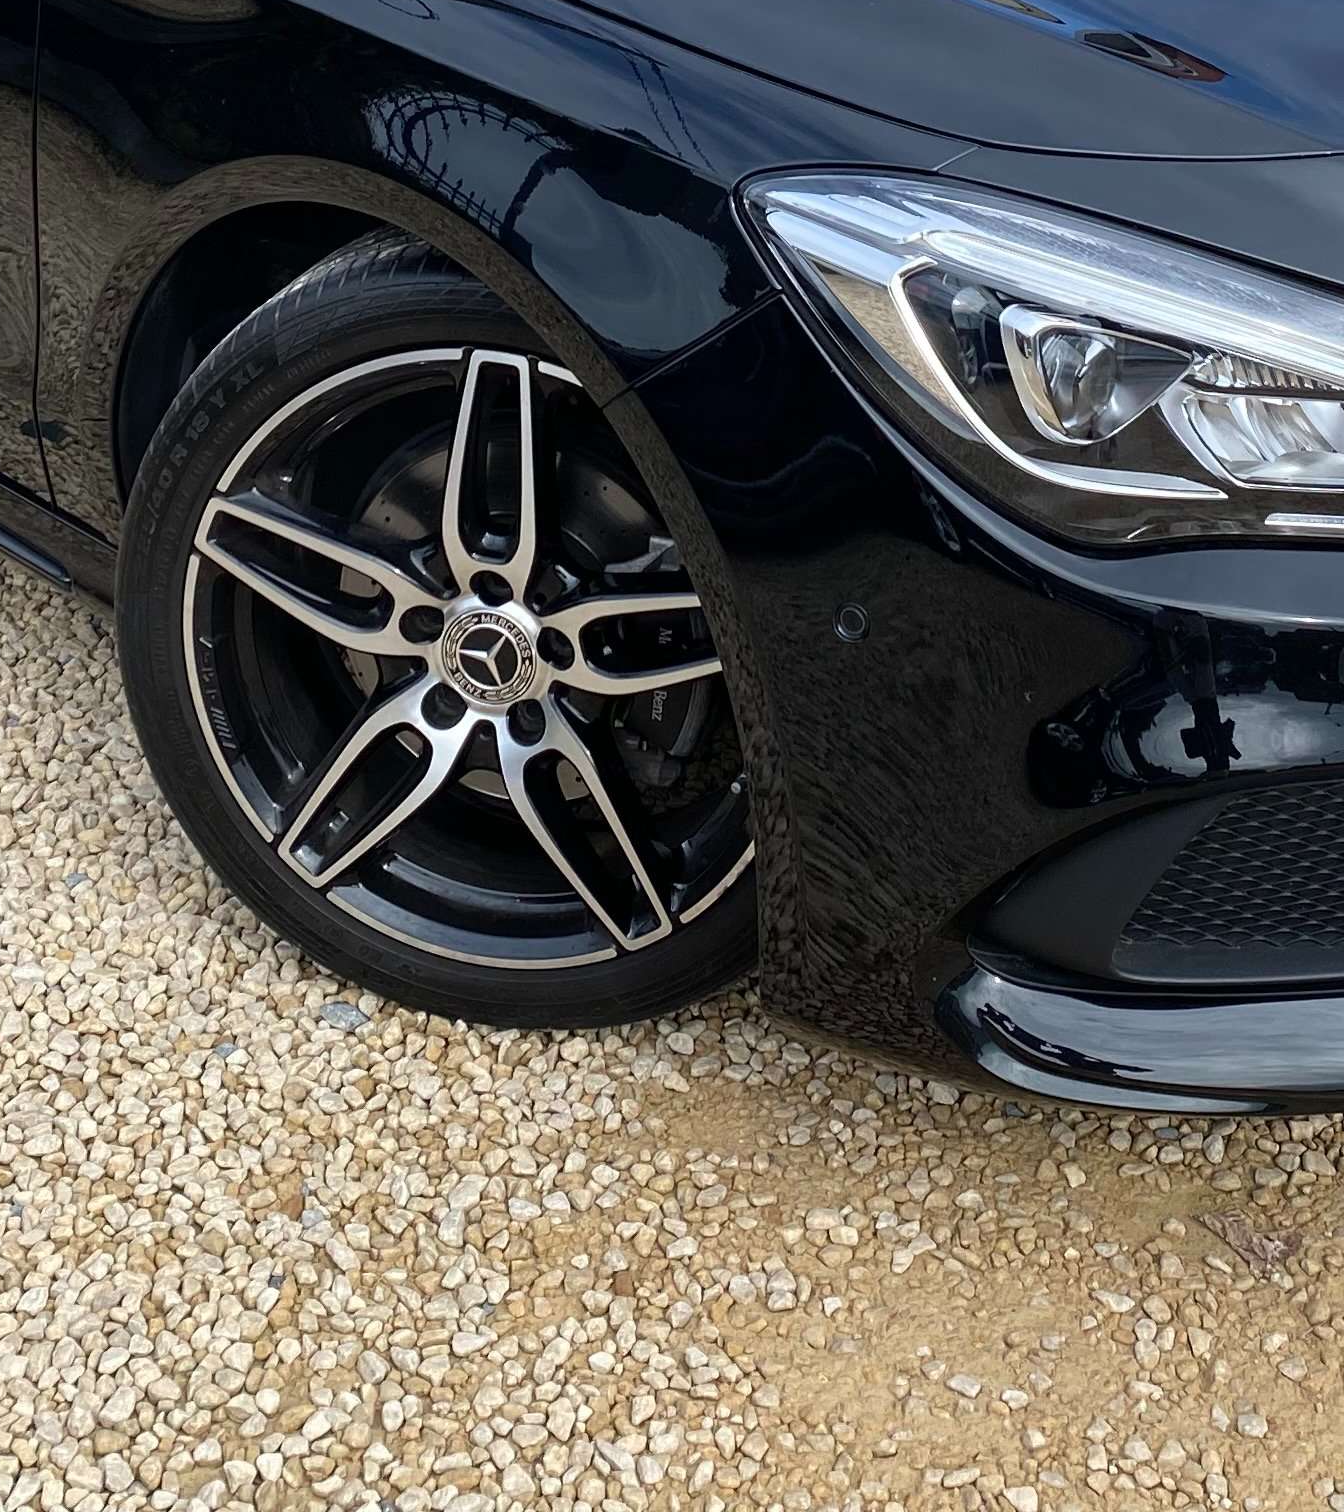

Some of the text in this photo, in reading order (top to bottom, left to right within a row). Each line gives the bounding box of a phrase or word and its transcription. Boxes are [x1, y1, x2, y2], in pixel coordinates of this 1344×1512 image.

[480, 614, 532, 659] MERCEDES
[454, 672, 483, 698] BENZ
[651, 690, 668, 722] Benz
